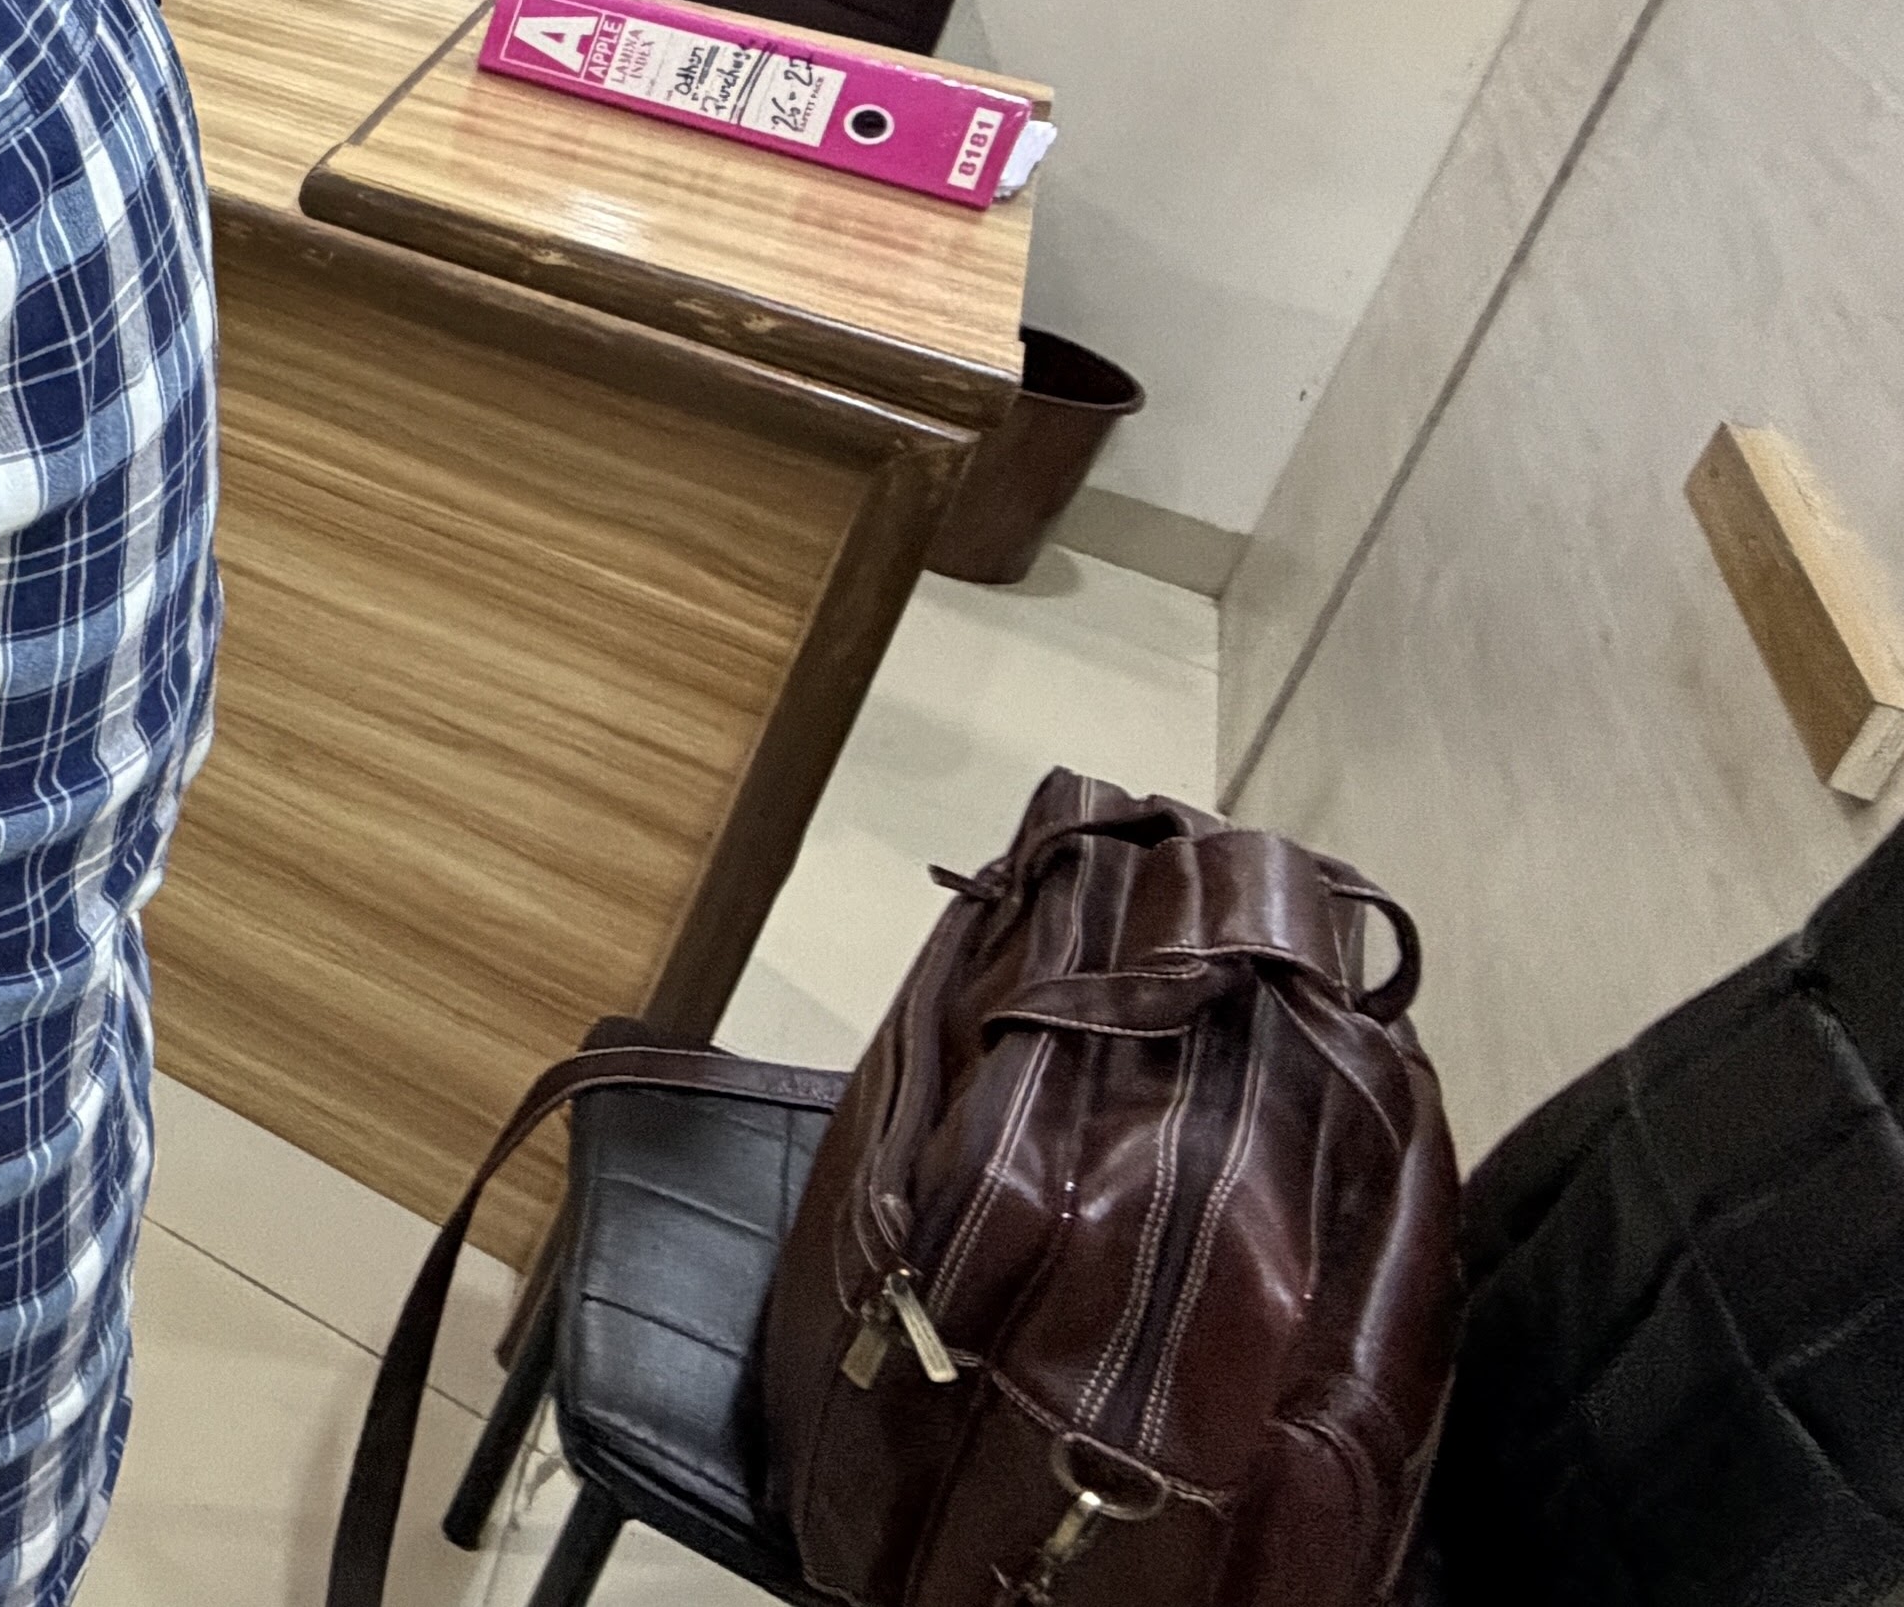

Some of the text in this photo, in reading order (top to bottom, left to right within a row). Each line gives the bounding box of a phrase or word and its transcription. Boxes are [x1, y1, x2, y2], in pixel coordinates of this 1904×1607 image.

[513, 16, 599, 73] A
[588, 20, 623, 79] APPLE
[611, 29, 645, 84] LAMINA
[629, 40, 655, 80] INDEX
[958, 120, 994, 176] 8181
